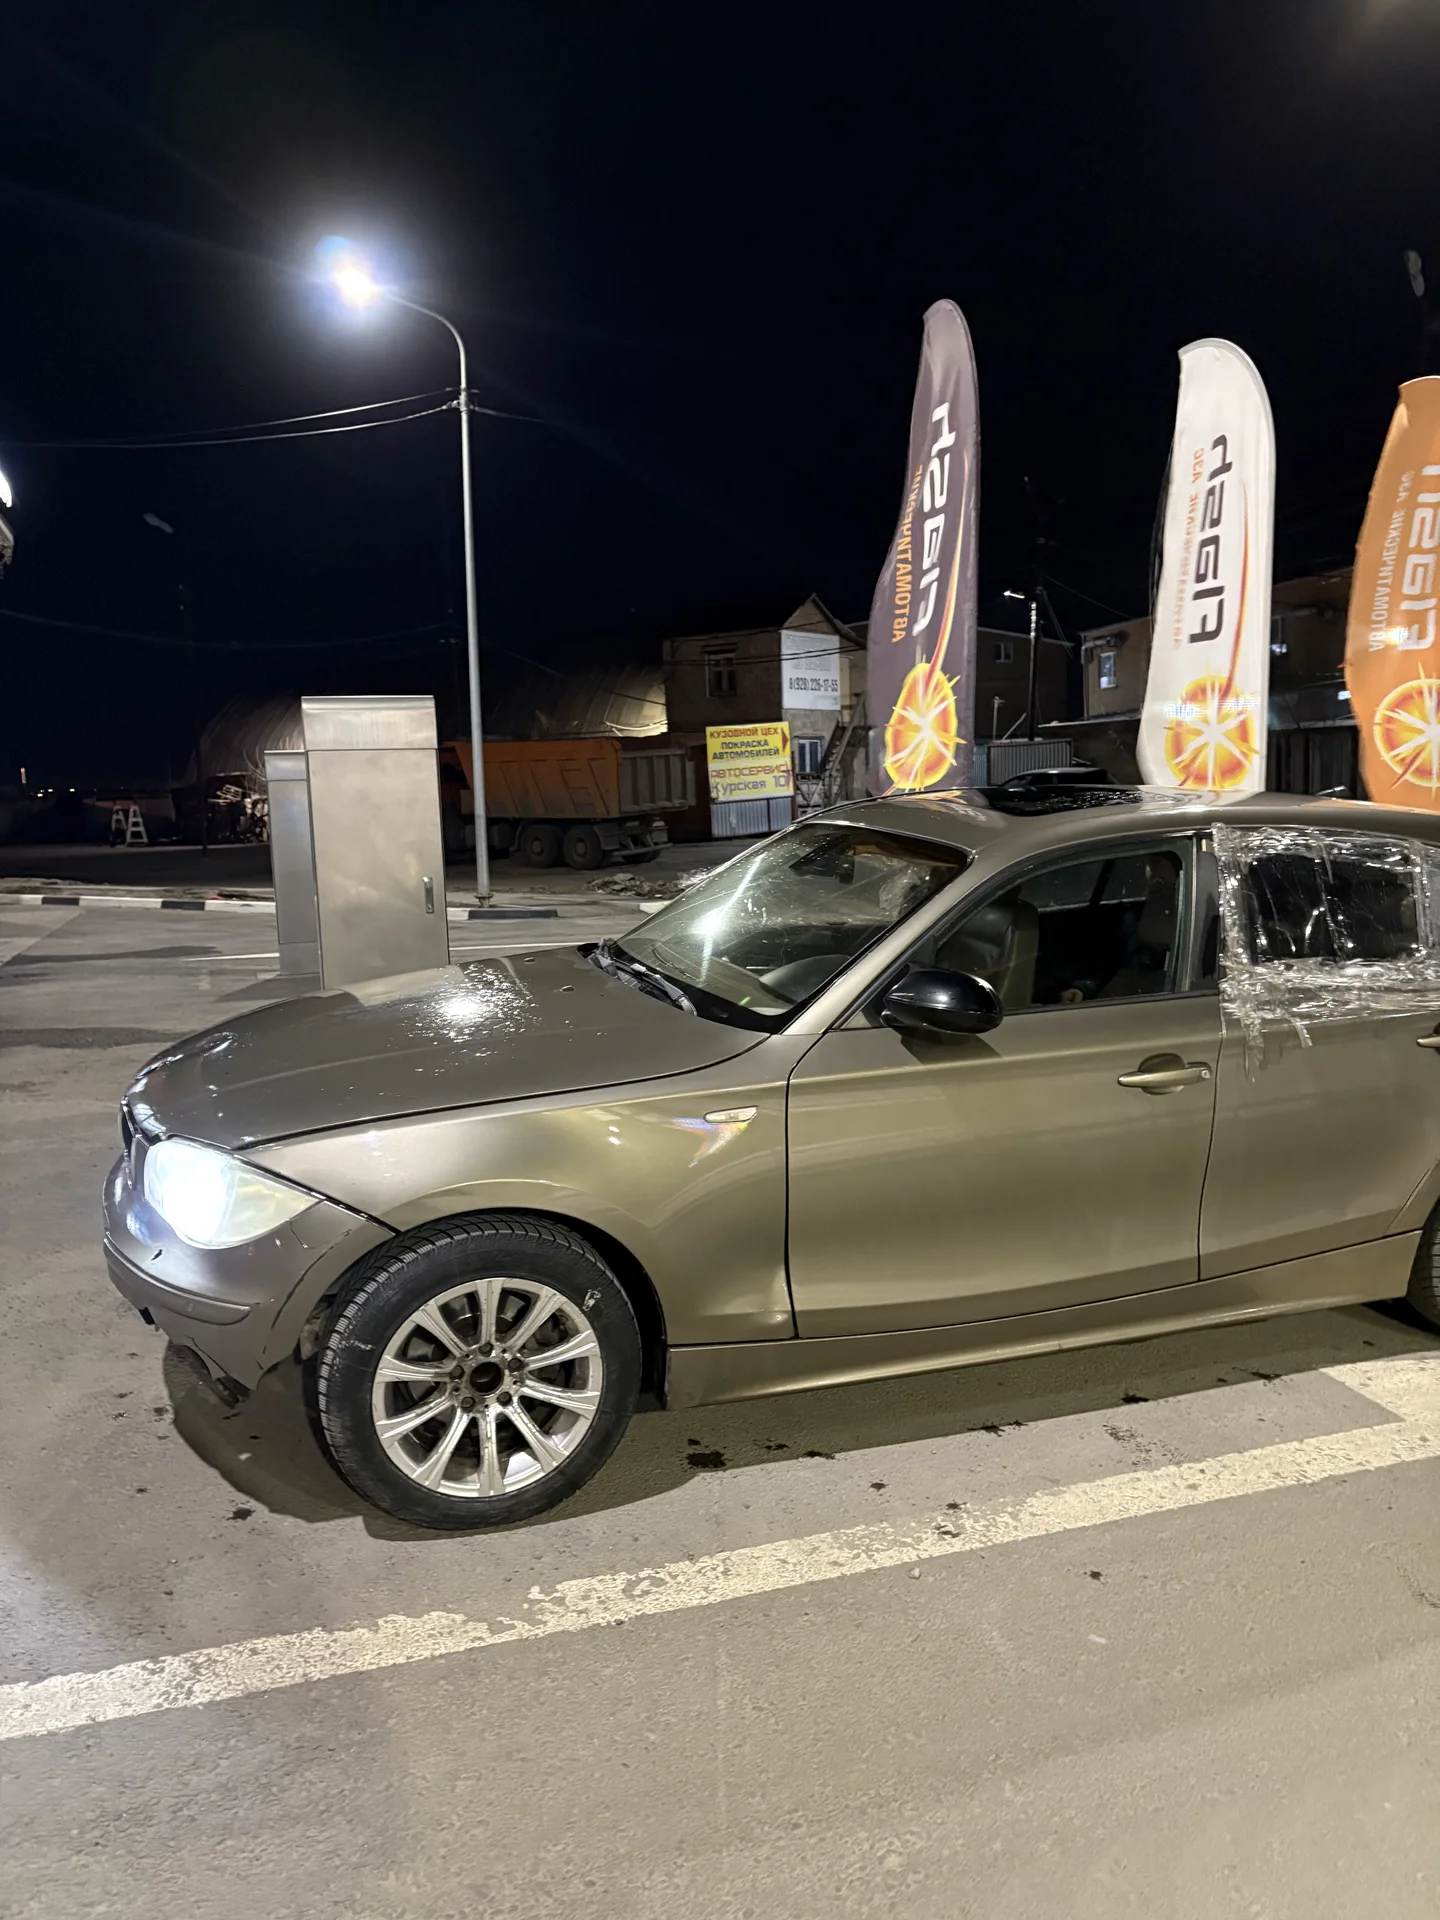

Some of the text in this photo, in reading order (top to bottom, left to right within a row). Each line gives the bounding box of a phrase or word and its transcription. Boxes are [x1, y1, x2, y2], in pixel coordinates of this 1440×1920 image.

[709, 727, 779, 739] КУЗОВНОЙ ЦЕХ
[721, 739, 769, 750] ПОКРАСКА
[712, 746, 779, 760] АВТОМОБИЛЕЙ
[711, 763, 787, 779] АВТОСЕРВИС
[711, 780, 766, 796] Курская
